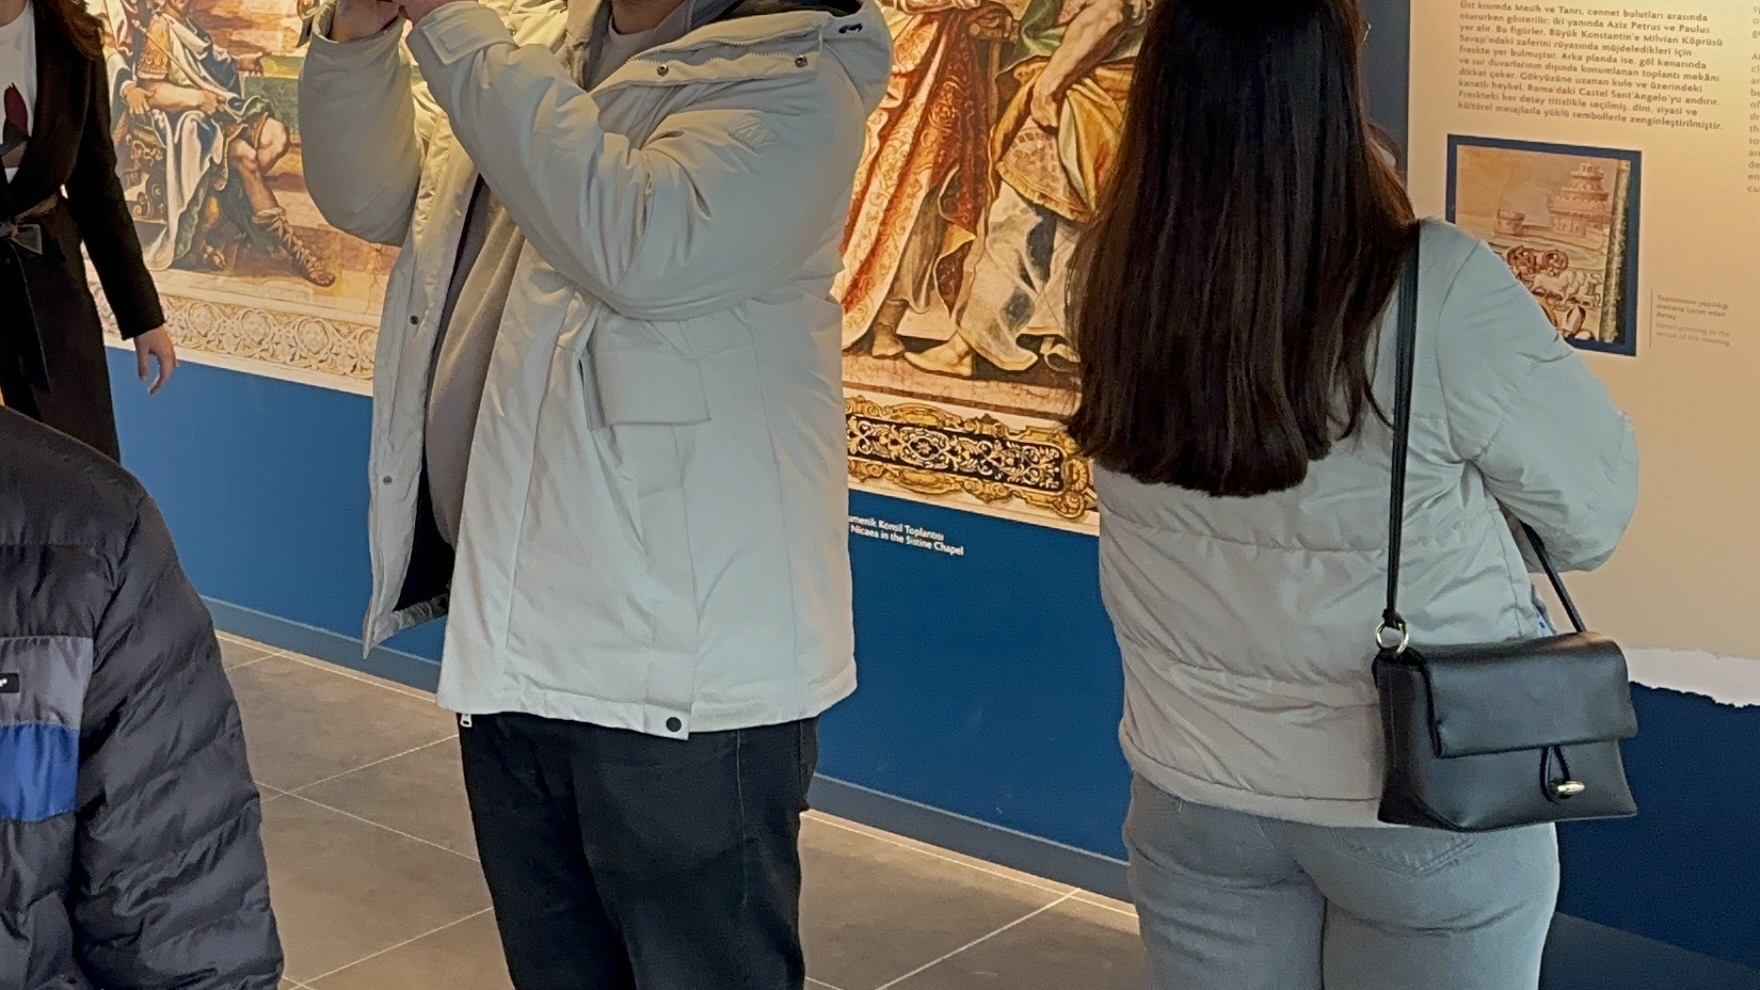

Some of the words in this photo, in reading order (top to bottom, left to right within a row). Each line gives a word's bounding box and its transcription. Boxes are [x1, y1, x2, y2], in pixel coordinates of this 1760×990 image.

[880, 530, 889, 540] in
[890, 532, 904, 544] the
[934, 541, 964, 556] Chapel
